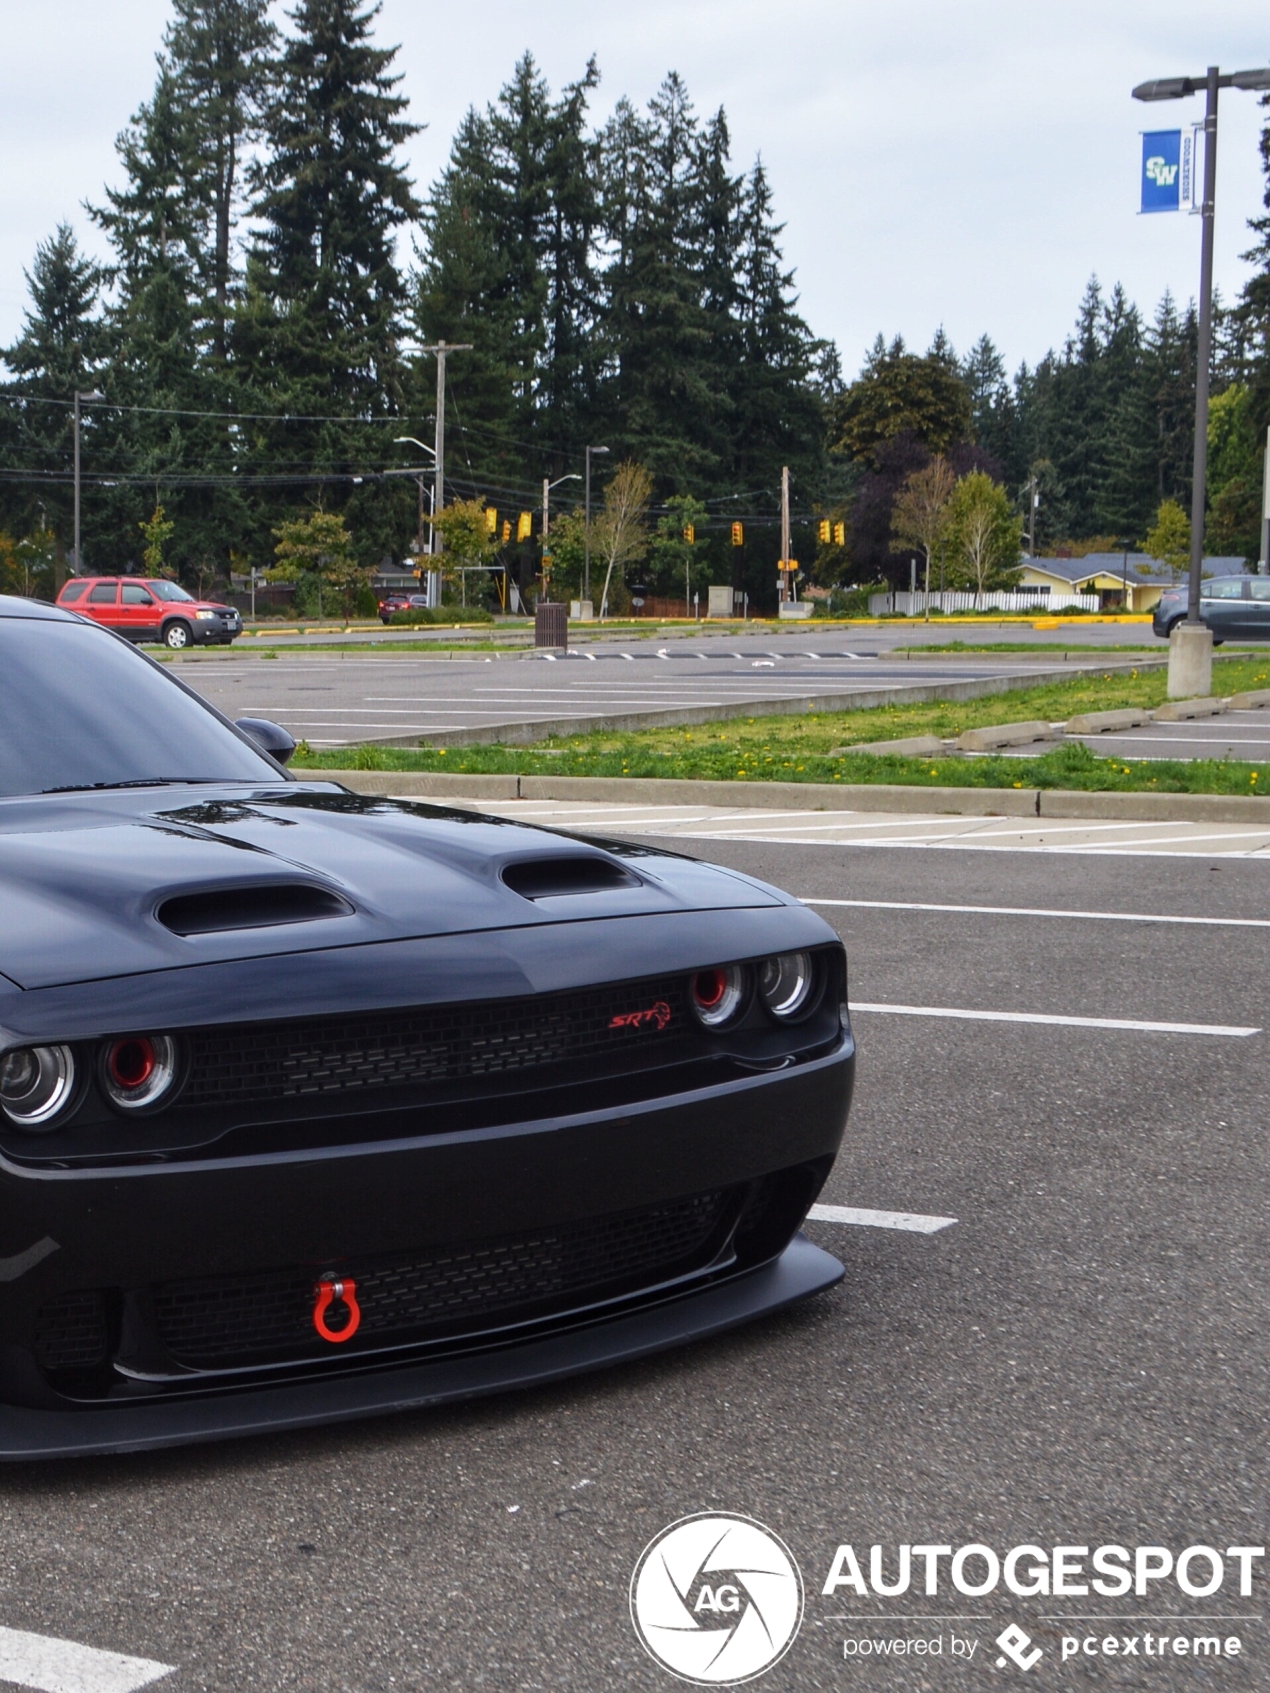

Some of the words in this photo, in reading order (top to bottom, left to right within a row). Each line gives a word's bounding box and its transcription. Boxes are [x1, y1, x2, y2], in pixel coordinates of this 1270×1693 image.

[1146, 156, 1178, 187] SW
[1183, 137, 1191, 200] SHOREWOOD
[609, 1009, 658, 1028] SRT
